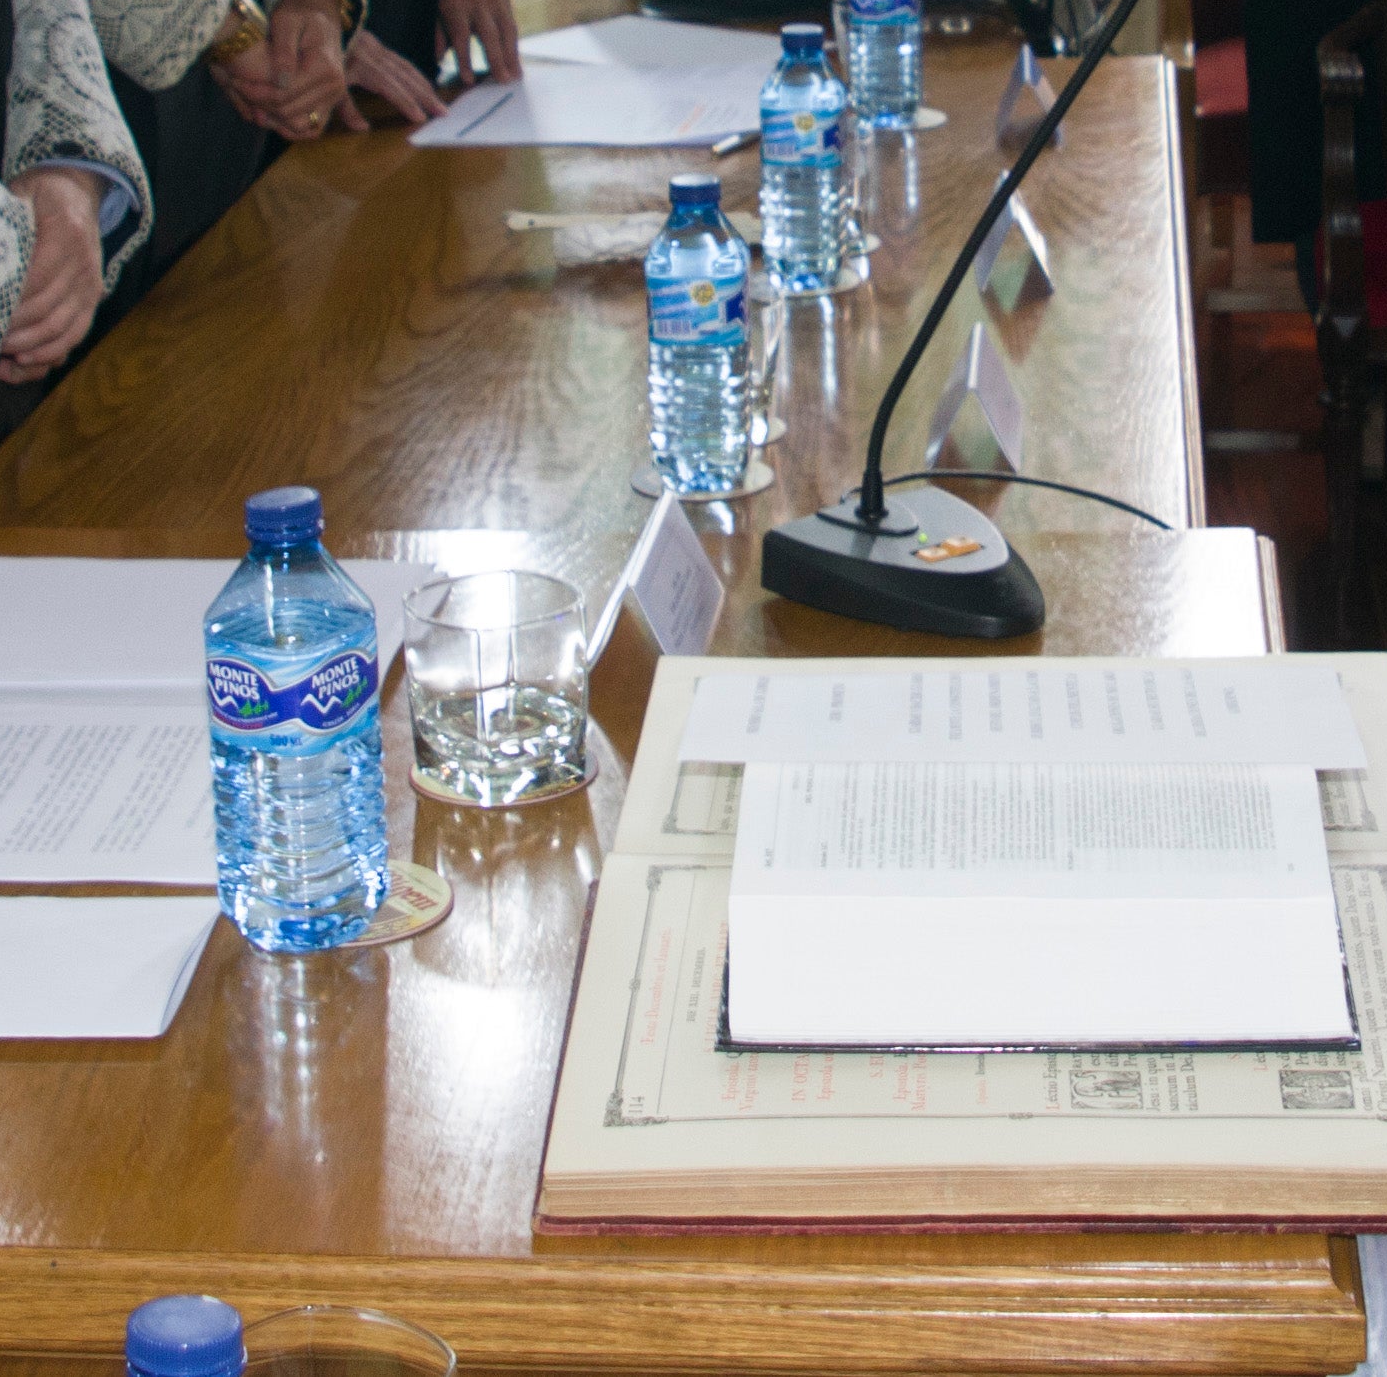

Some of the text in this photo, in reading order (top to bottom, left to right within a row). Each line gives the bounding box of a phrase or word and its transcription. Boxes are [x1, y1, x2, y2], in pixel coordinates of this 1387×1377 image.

[209, 662, 258, 686] MONTE
[312, 656, 358, 689] MONTE
[215, 677, 260, 700] PINOS
[318, 671, 359, 699] PINOS
[791, 1053, 810, 1101] IN OCTA
[1146, 1058, 1164, 1074] quo
[628, 1096, 644, 1113] 114
